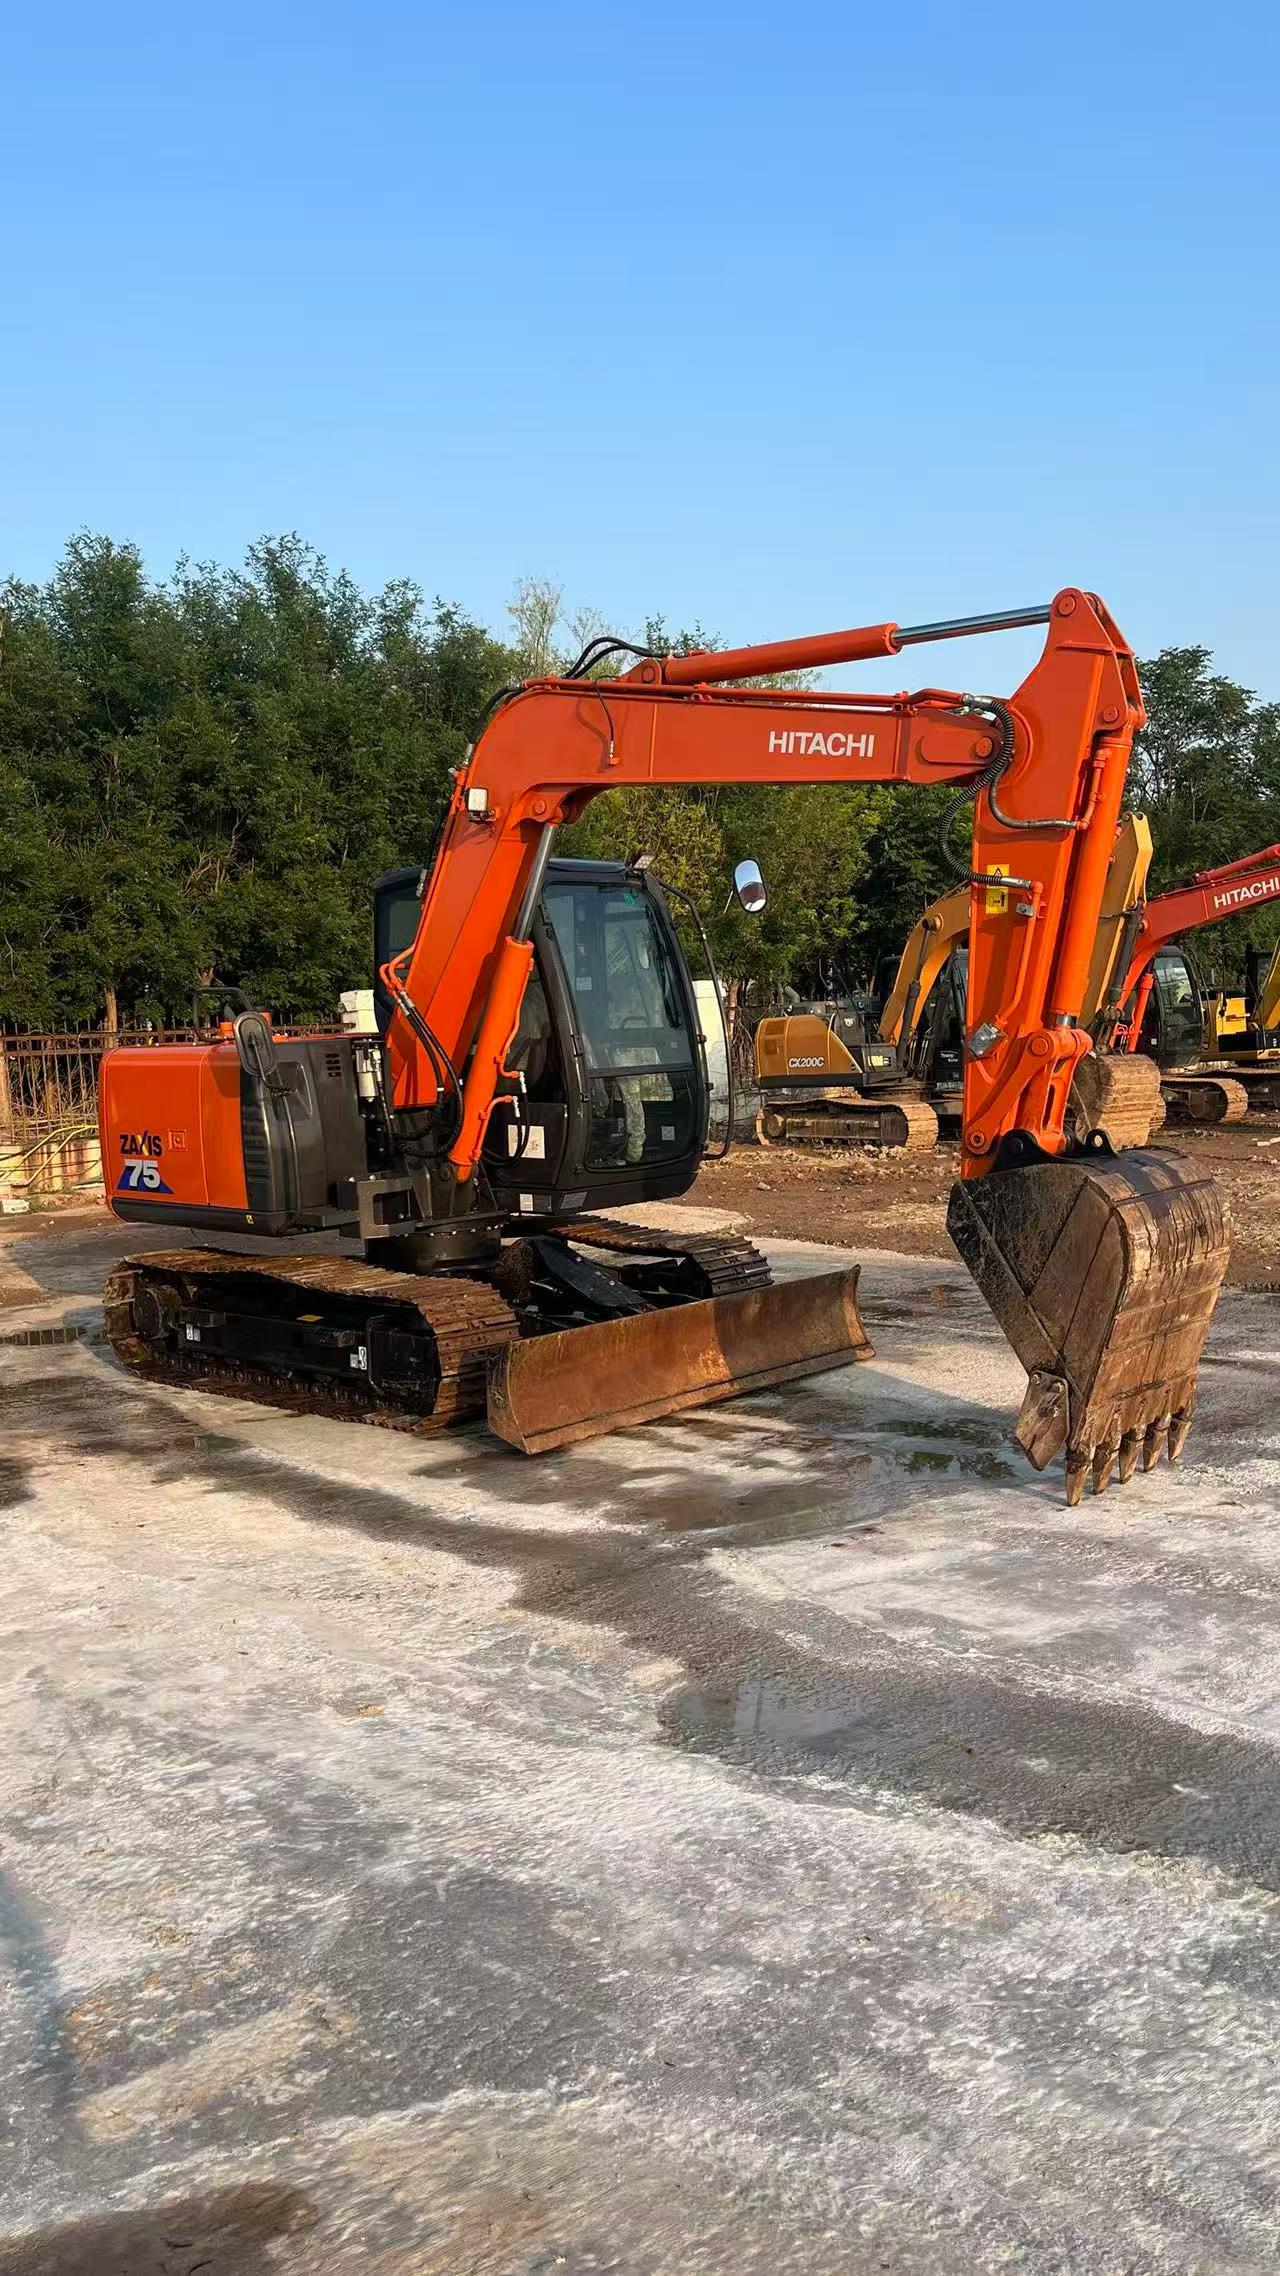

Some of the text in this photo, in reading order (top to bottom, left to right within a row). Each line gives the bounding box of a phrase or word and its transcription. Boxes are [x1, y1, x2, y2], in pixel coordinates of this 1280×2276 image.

[768, 731, 875, 757] HITACHI
[1213, 877, 1280, 909] HITACHI
[788, 1057, 824, 1068] CX200C
[120, 1130, 163, 1157] ZAXIS
[124, 1159, 160, 1189] 75
